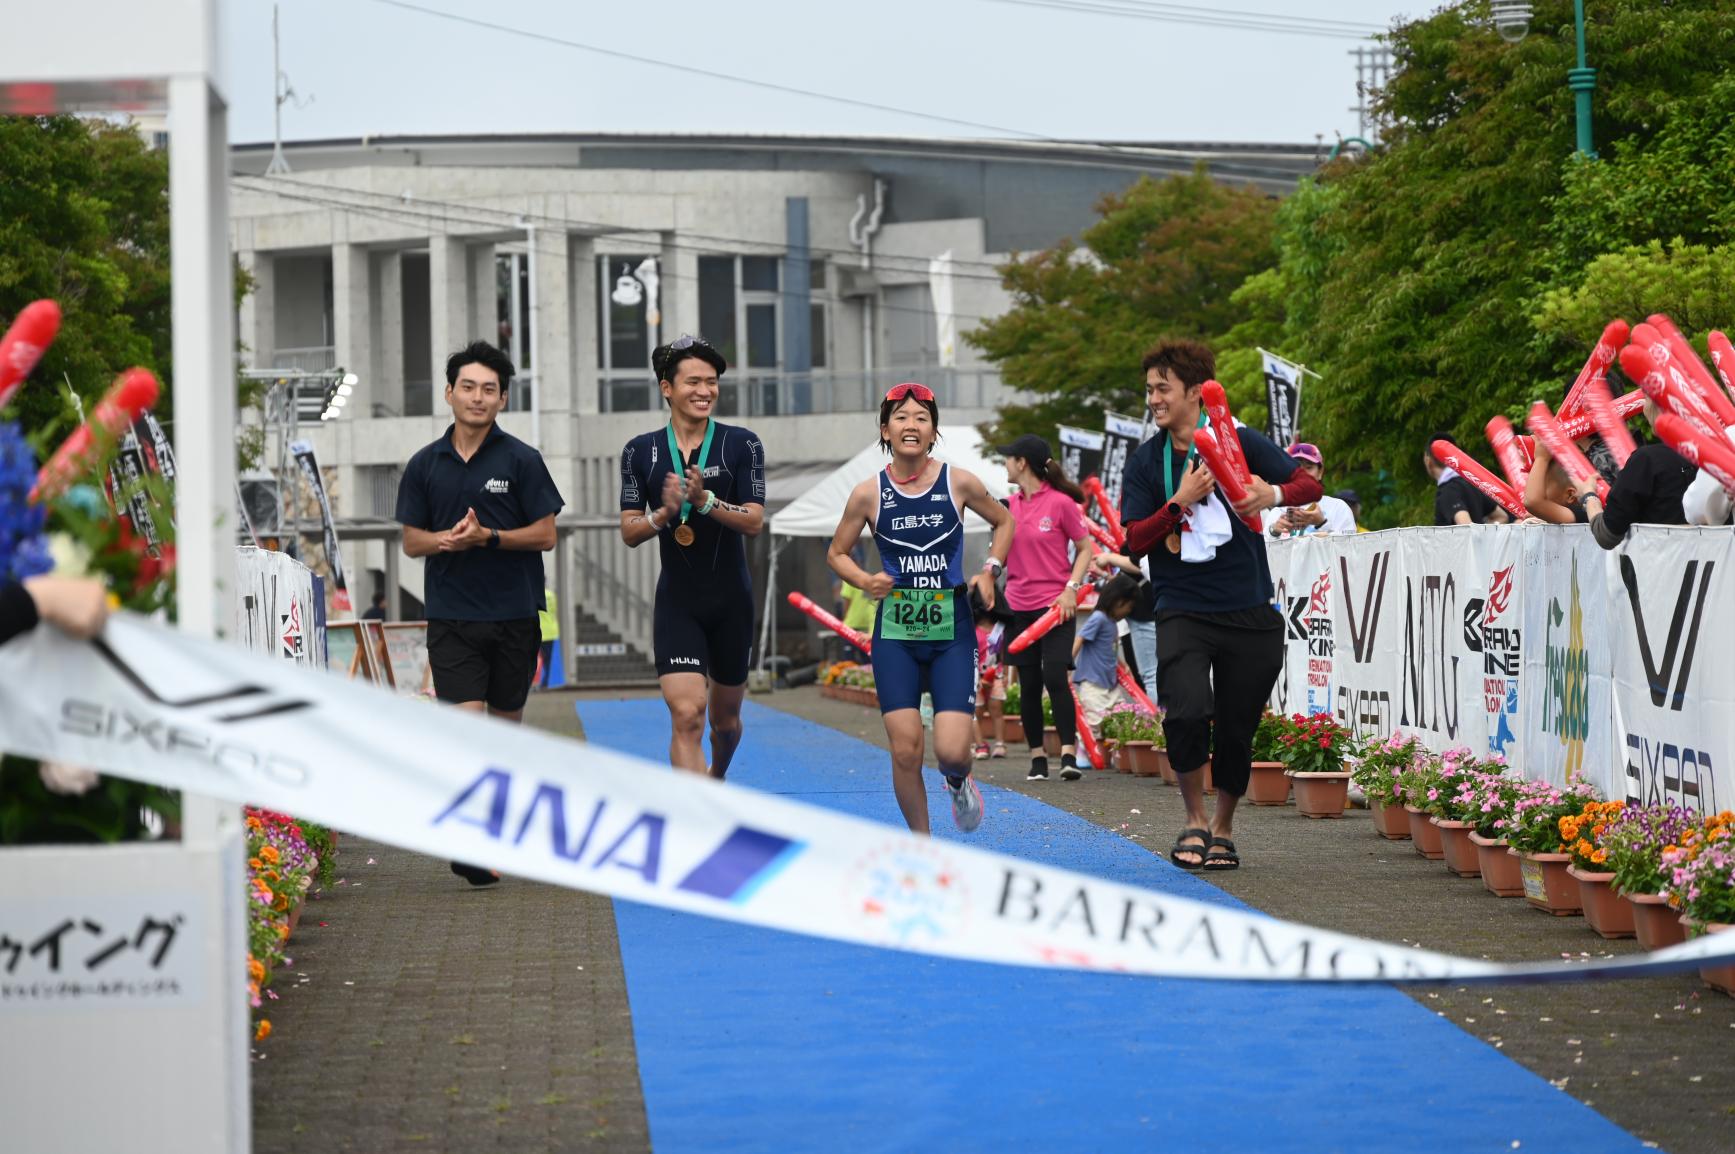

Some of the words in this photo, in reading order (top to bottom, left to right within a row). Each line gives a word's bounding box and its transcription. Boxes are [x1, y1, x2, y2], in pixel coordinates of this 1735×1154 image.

[891, 513, 944, 531] 広島大学
[898, 553, 948, 574] YAMADA
[894, 603, 943, 625] 1246
[670, 656, 700, 666] HUUB
[431, 767, 667, 886] ANA
